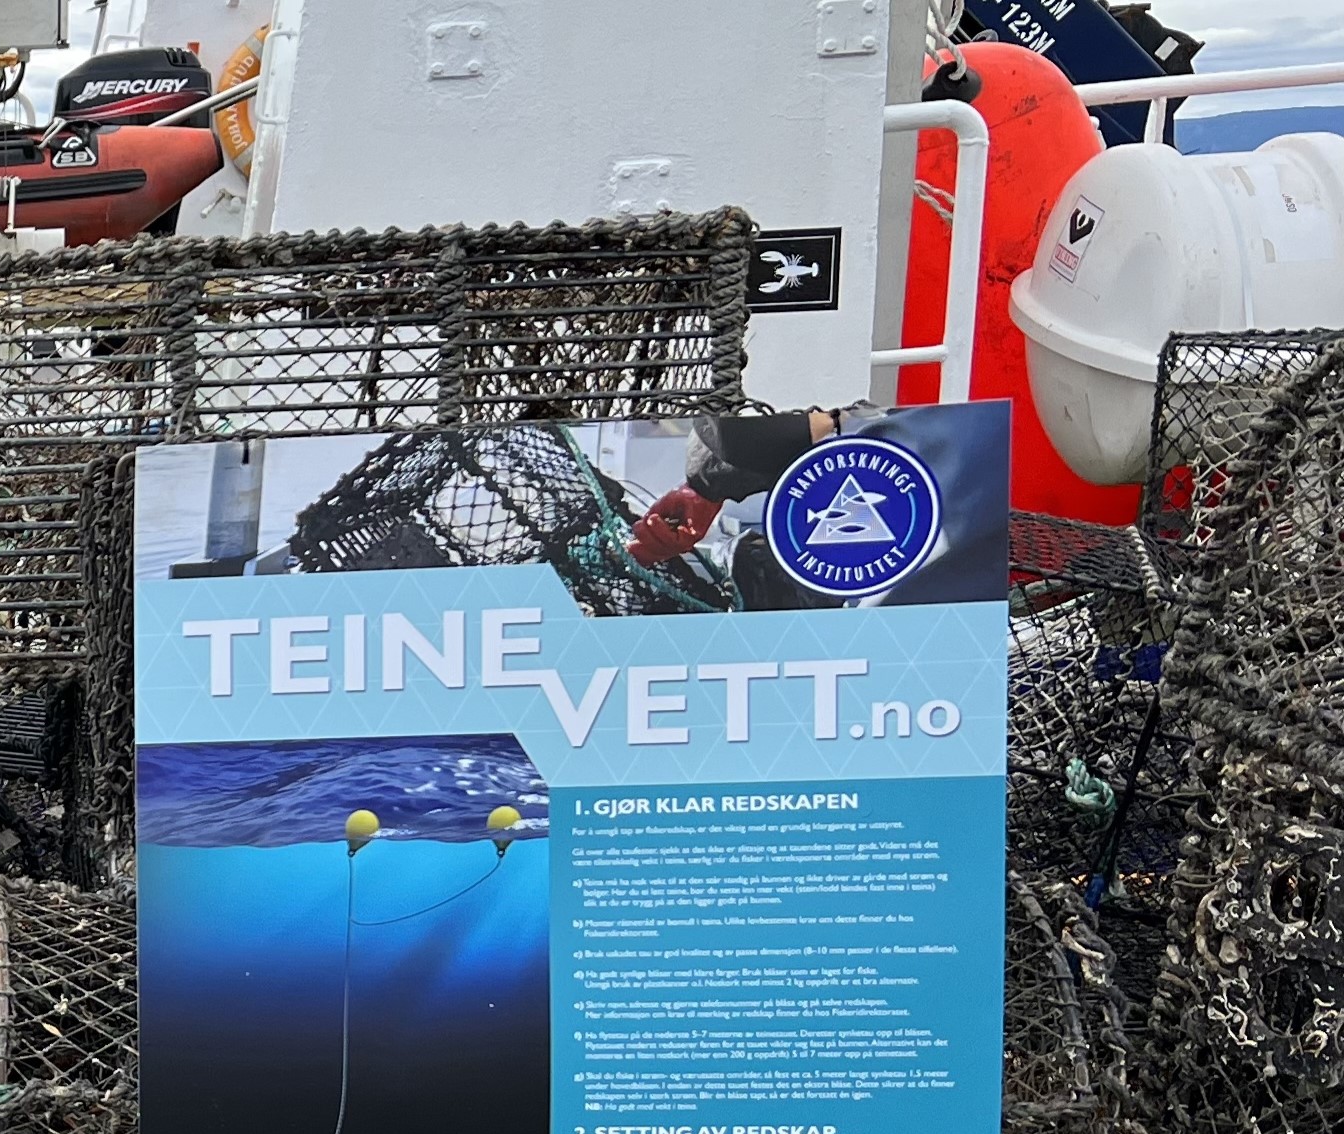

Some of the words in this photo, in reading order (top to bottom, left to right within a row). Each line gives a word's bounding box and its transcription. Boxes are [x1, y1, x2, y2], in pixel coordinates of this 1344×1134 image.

[73, 78, 188, 103] MERCURY
[788, 438, 918, 499] HAVFORSKNINGS
[795, 547, 910, 585] INSTITUTTET
[181, 607, 544, 697] TEINE
[538, 658, 963, 748] VETT.no
[575, 799, 590, 815] 1.
[593, 798, 651, 818] GJØR
[656, 797, 716, 813] KLAR
[721, 793, 859, 812] REDSKAPEN
